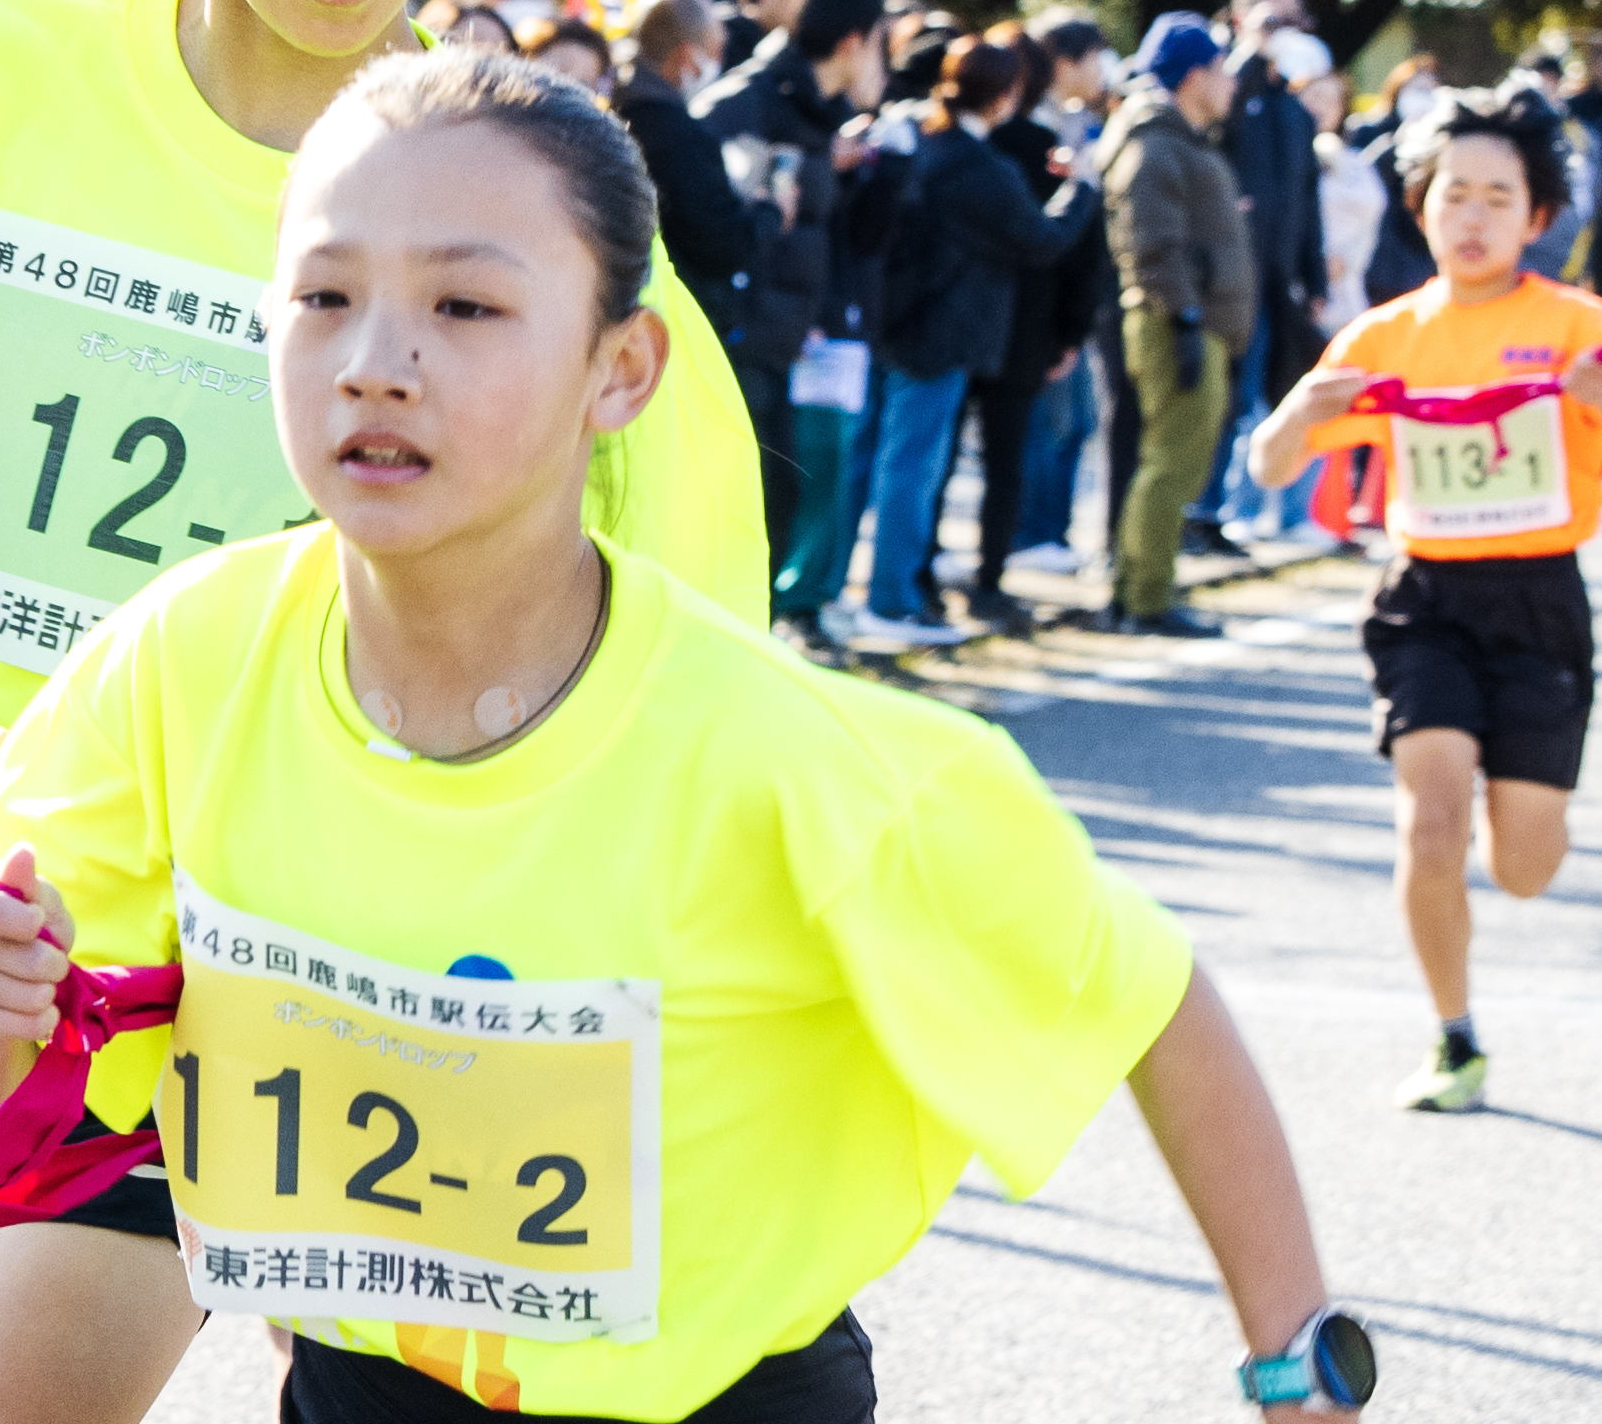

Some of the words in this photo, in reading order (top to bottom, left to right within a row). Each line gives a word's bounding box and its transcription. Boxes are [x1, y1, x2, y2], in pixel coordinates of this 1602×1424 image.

[181, 904, 605, 1035] 第48回鹿嶋市駅伝大会
[174, 1050, 588, 1245] 112-2
[203, 1241, 602, 1323] 東洋計測株式会社
